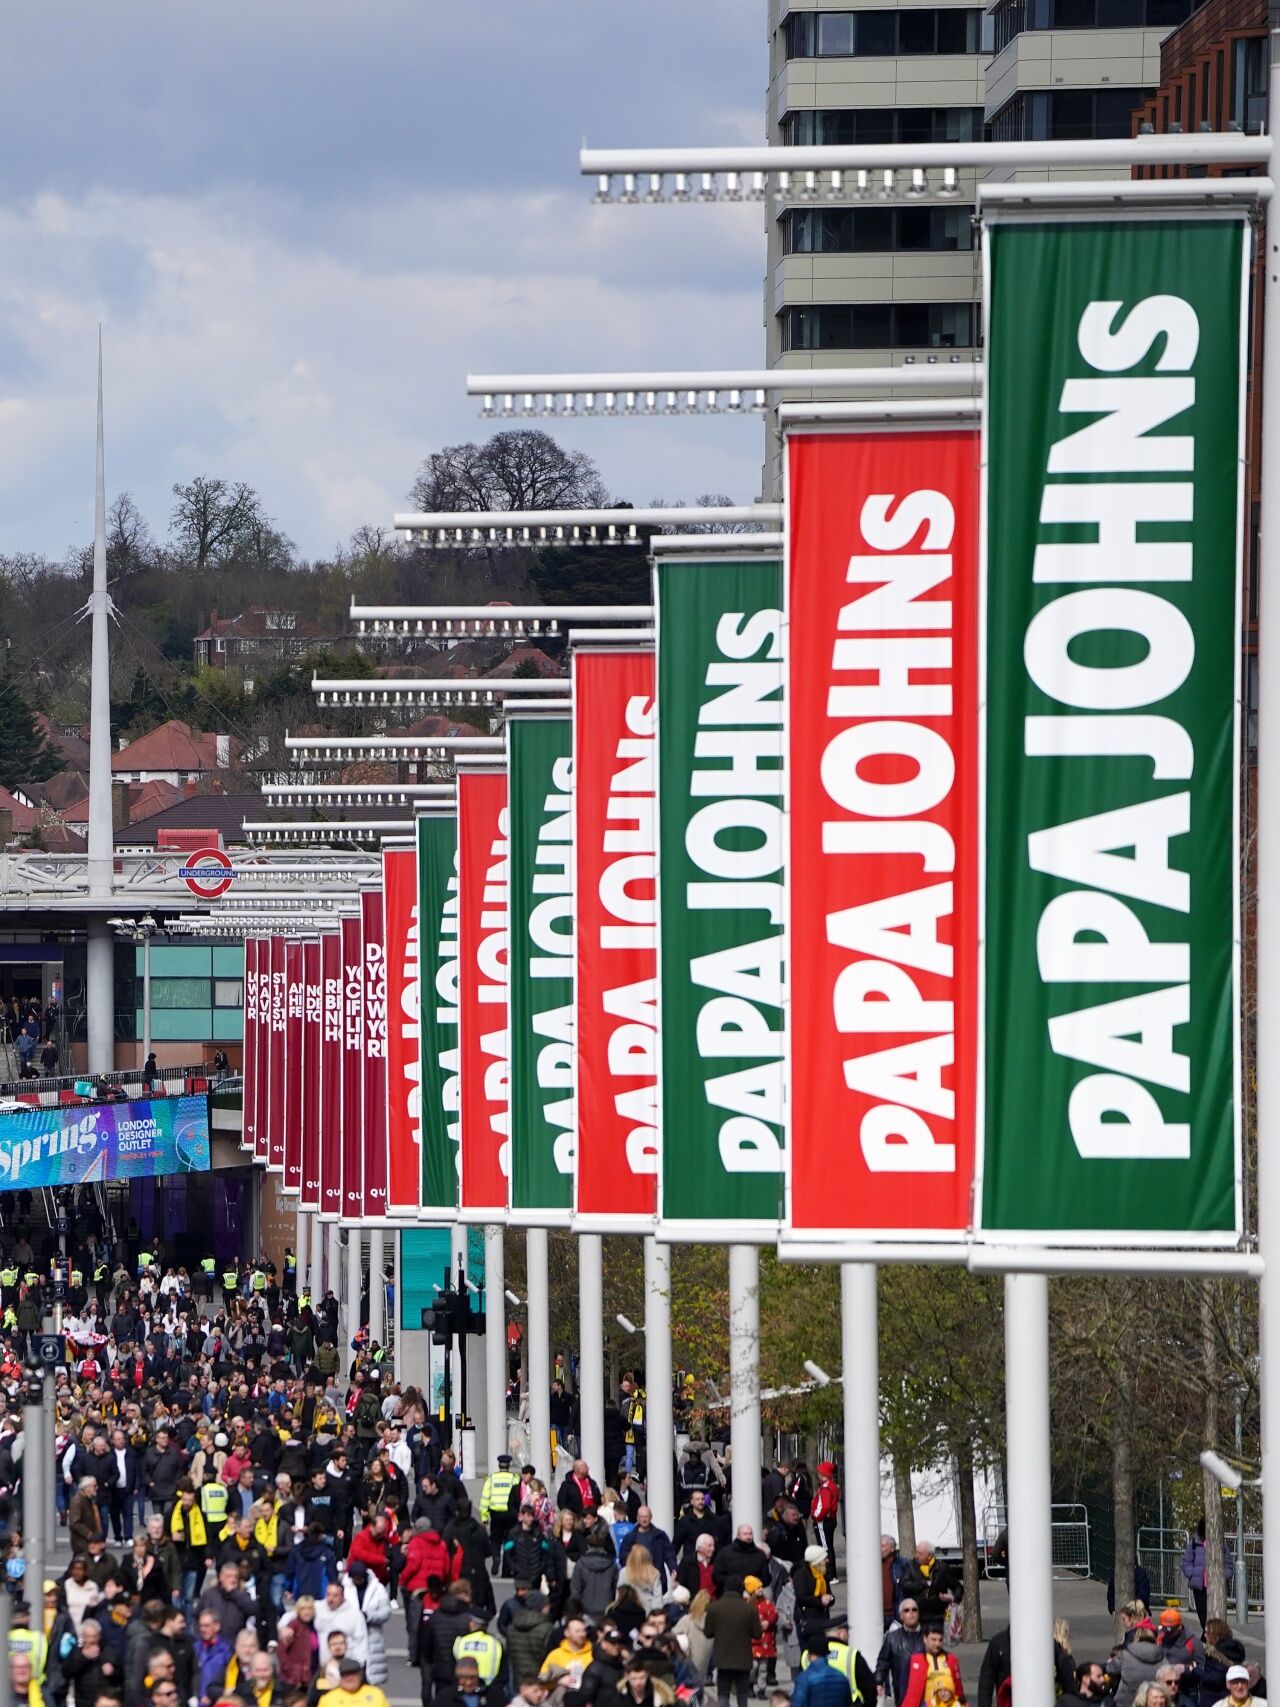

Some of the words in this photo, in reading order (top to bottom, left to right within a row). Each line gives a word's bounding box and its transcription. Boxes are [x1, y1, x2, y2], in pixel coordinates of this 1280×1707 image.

[180, 869, 237, 877] UNDERGROUND
[118, 1118, 157, 1131] LONDON
[118, 1128, 163, 1141] DESIGNER
[118, 1139, 152, 1151] OUTLET
